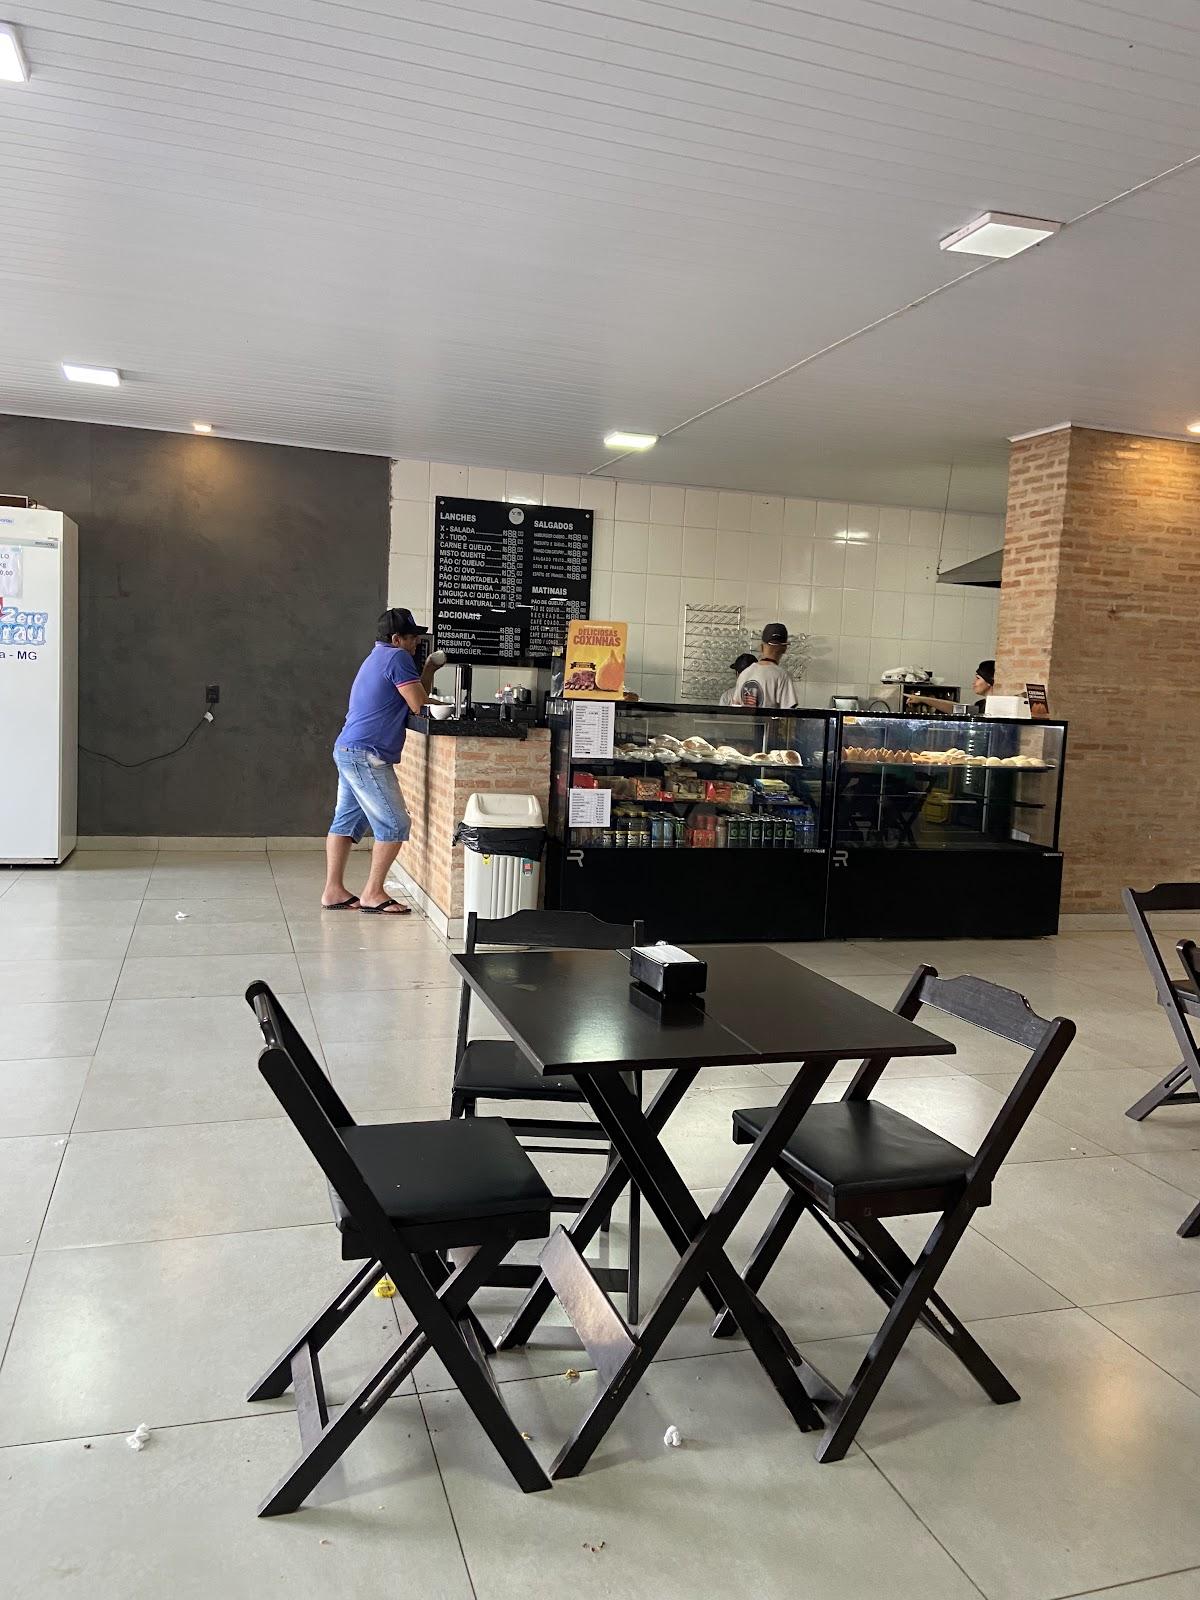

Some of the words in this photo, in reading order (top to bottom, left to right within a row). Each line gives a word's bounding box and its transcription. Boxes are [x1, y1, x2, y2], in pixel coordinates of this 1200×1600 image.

[440, 512, 477, 522] LANCHES
[534, 520, 573, 530] SALGADOS
[450, 526, 475, 534] SALADA
[460, 551, 486, 559] QUENTE
[461, 576, 499, 584] MORTADELA
[439, 590, 468, 598] LINGUIÇA
[532, 586, 568, 596] MATINAIS
[1, 608, 45, 625] Zero
[438, 611, 481, 620] ADCIONAIS
[438, 632, 476, 640] MUSSARELA
[579, 628, 618, 637] DELICIOSAS
[574, 636, 621, 646] COXINHAS
[18, 650, 37, 660] MG
